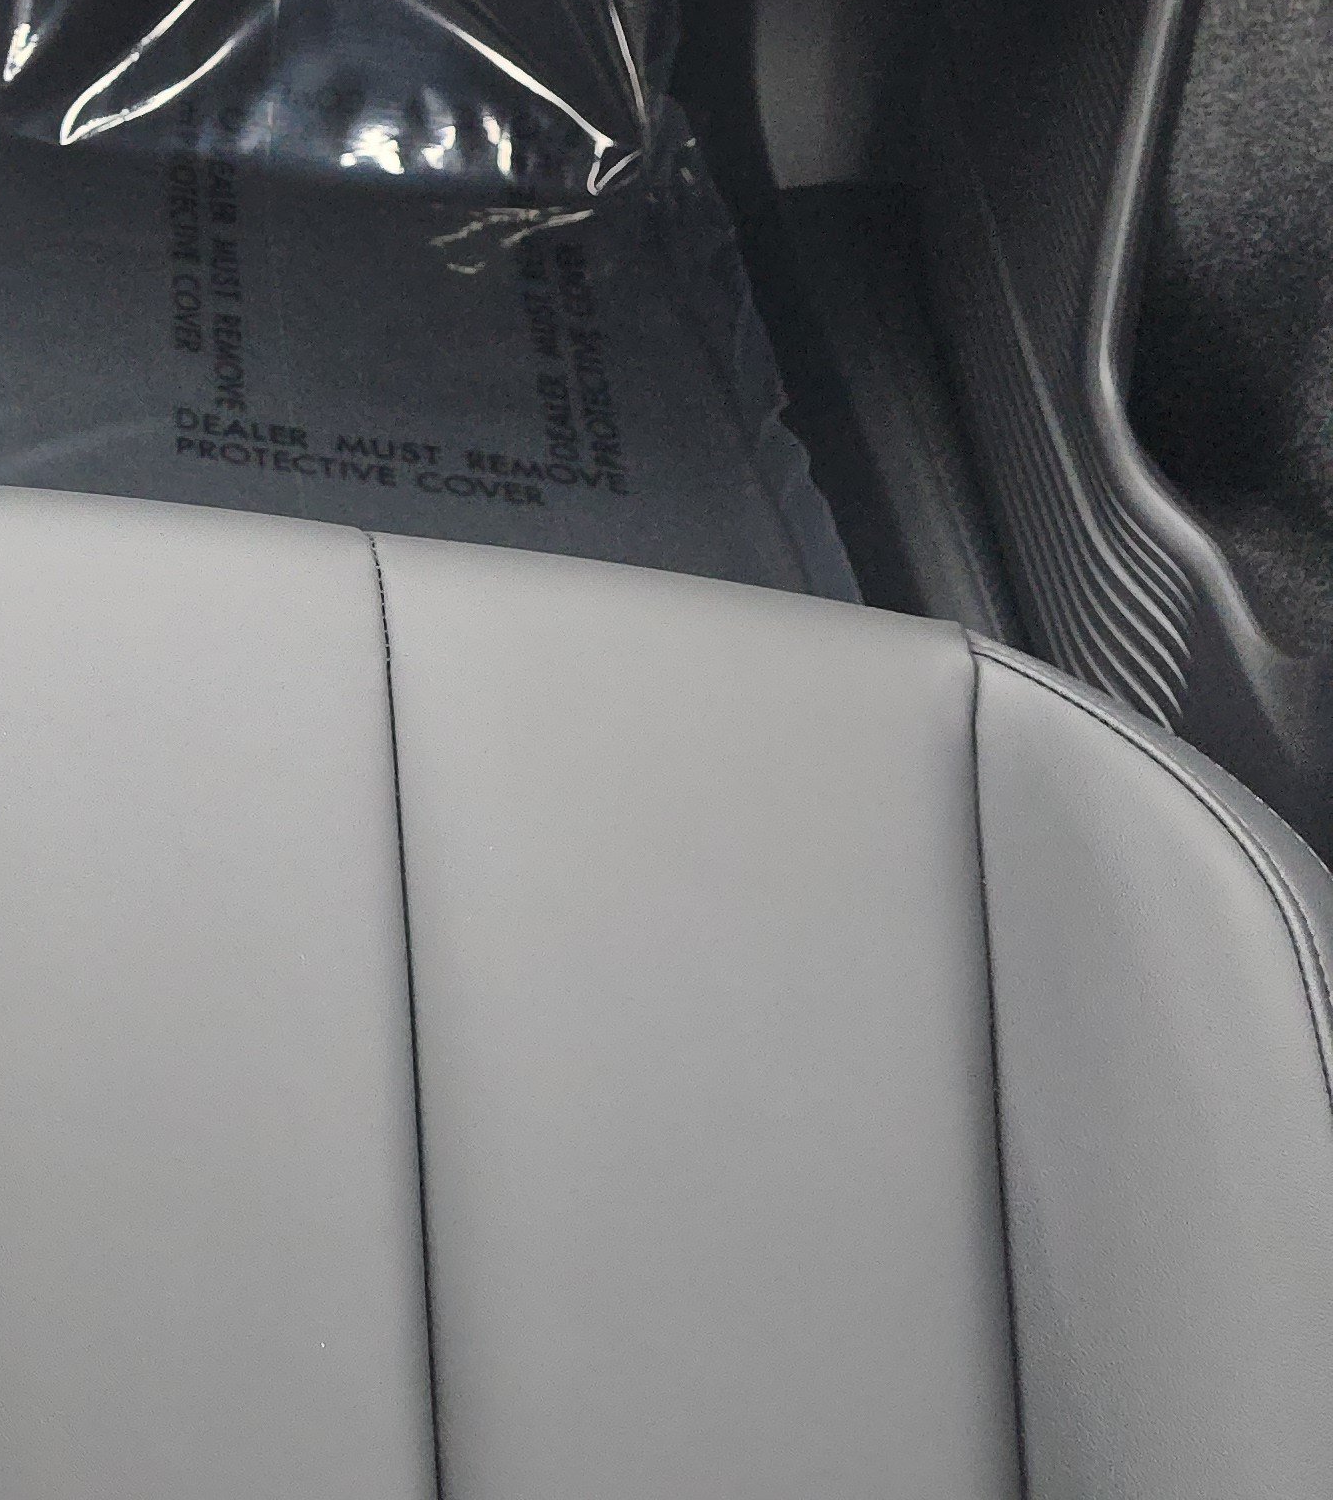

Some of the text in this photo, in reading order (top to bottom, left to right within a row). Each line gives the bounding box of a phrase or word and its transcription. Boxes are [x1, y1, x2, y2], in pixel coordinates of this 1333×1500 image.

[172, 272, 203, 353] COVER
[175, 406, 631, 496] DEALER MUST REMOVE
[175, 435, 546, 507] PROTECTIVE COVER
